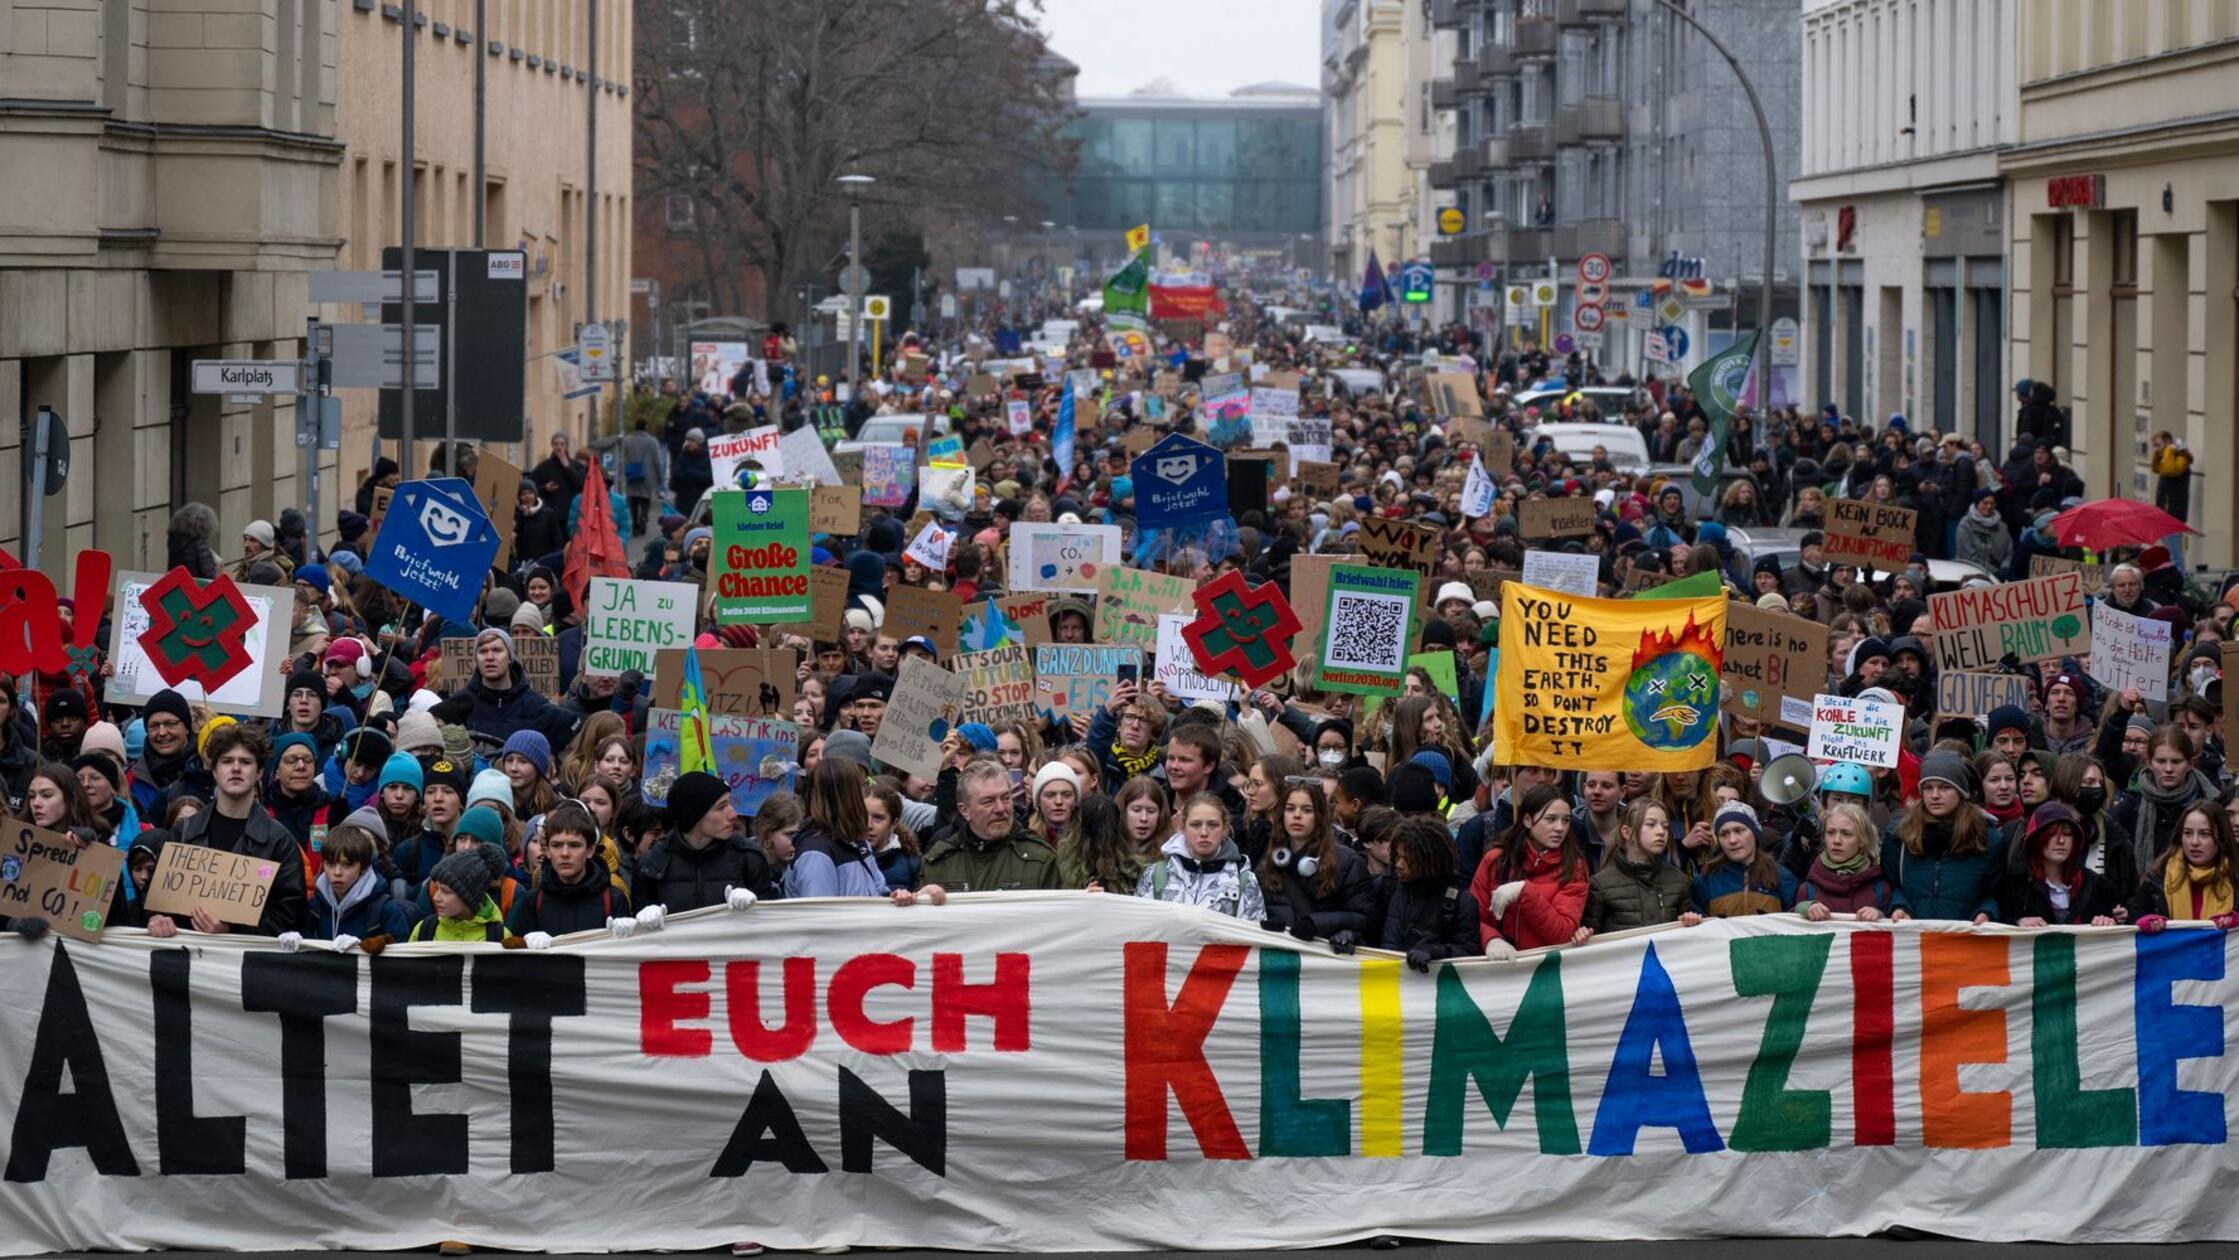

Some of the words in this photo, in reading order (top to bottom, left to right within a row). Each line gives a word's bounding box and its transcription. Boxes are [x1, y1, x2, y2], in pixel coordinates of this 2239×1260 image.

[490, 260, 510, 269] ABG
[1586, 261, 1604, 276] 30
[1661, 250, 1702, 278] dm
[221, 367, 273, 386] Karlplatz
[710, 431, 779, 459] ZUKUNFT
[1152, 486, 1210, 504] Briefwahl
[1876, 509, 1912, 531] BOCK
[726, 542, 798, 570] Große
[393, 545, 461, 591] Briefwahl
[718, 572, 809, 599] Chance
[1335, 571, 1387, 589] Briefwahl
[602, 582, 636, 612] JA
[1518, 597, 1572, 620] YOU
[1932, 574, 2084, 631] KLIMASCHUTZ
[722, 607, 743, 616] Berlin
[744, 606, 761, 615] 2030
[590, 616, 686, 645] LEBENS-
[1525, 622, 1597, 648] NEED
[1724, 624, 1764, 648] here
[1768, 628, 1782, 648] is
[1788, 637, 1808, 653] no
[991, 646, 1024, 664] OUR
[1939, 629, 1997, 670] WEIL
[2000, 619, 2052, 659] BAUM
[1036, 648, 1074, 676] GANZ
[1158, 663, 1178, 680] NO
[1555, 652, 1608, 674] THIS
[1722, 659, 1763, 680] anet
[1178, 667, 1236, 695] PROBLEM
[1322, 671, 1400, 689] berlin2030.org
[1524, 669, 1600, 692] EARTH,
[964, 689, 989, 709] SO
[991, 682, 1032, 705] STOP
[1068, 678, 1110, 711] EIS
[1524, 693, 1539, 708] SO
[1553, 696, 1598, 712] DON'T
[1940, 673, 1966, 714] GO
[1972, 674, 2029, 714] VEGAN
[1023, 701, 1036, 720] IT
[1816, 707, 1857, 723] KOHLE
[1864, 714, 1872, 724] in
[1865, 703, 1880, 712] die
[774, 723, 797, 743] ins
[1524, 713, 1617, 736] DESTROY
[1833, 723, 1893, 742] ZUKUNFT
[1551, 740, 1583, 756] IT
[1823, 744, 1887, 763] KRAFTWERK
[1854, 738, 1868, 748] ins
[15, 828, 80, 866] Spread
[169, 844, 220, 874] THERE
[229, 858, 251, 881] IS
[2, 883, 31, 904] not
[68, 867, 116, 904] LOVE
[162, 871, 185, 892] NO
[189, 876, 248, 904] PLANET
[251, 885, 267, 908] B
[639, 952, 1031, 1060] EUCH
[1123, 927, 2228, 1161] KLIMAZIELE
[4, 940, 586, 1182] ALTET
[710, 1068, 947, 1178] AN
